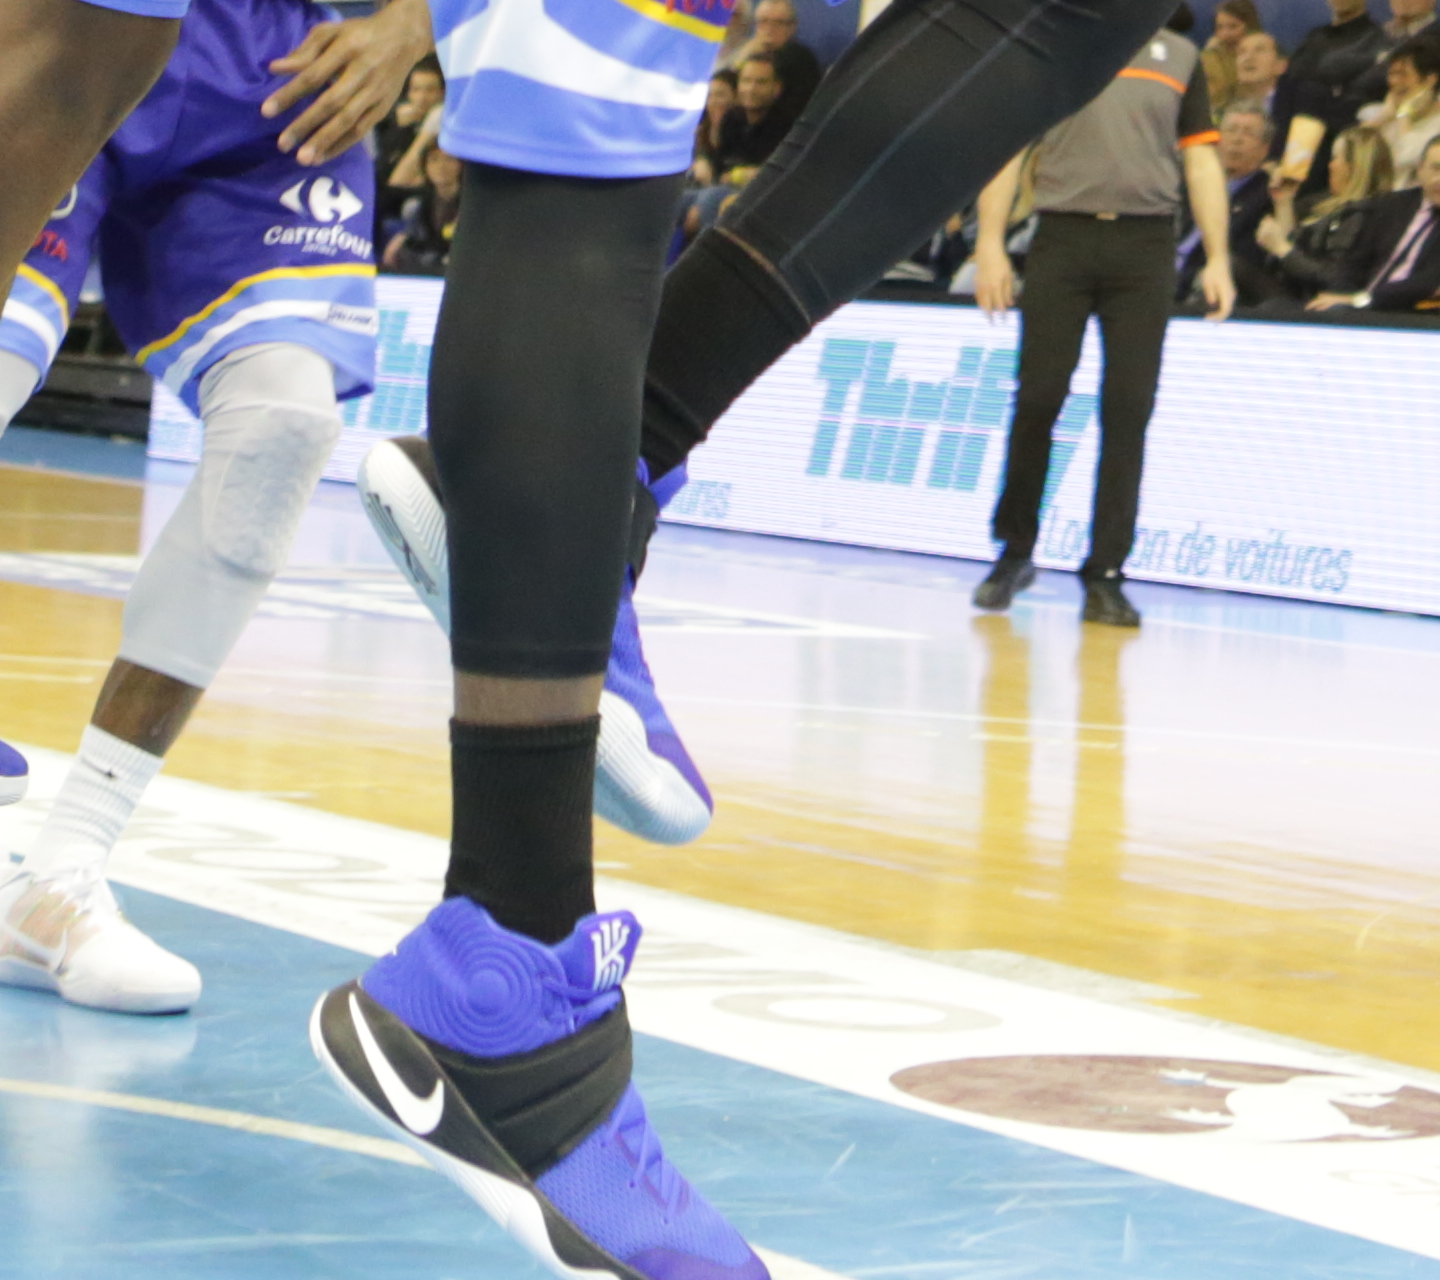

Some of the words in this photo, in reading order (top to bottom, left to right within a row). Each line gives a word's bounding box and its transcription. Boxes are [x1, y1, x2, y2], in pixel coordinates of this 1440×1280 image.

[263, 223, 373, 259] Carrefou
[1181, 519, 1215, 576] de
[1226, 526, 1353, 593] voitures
